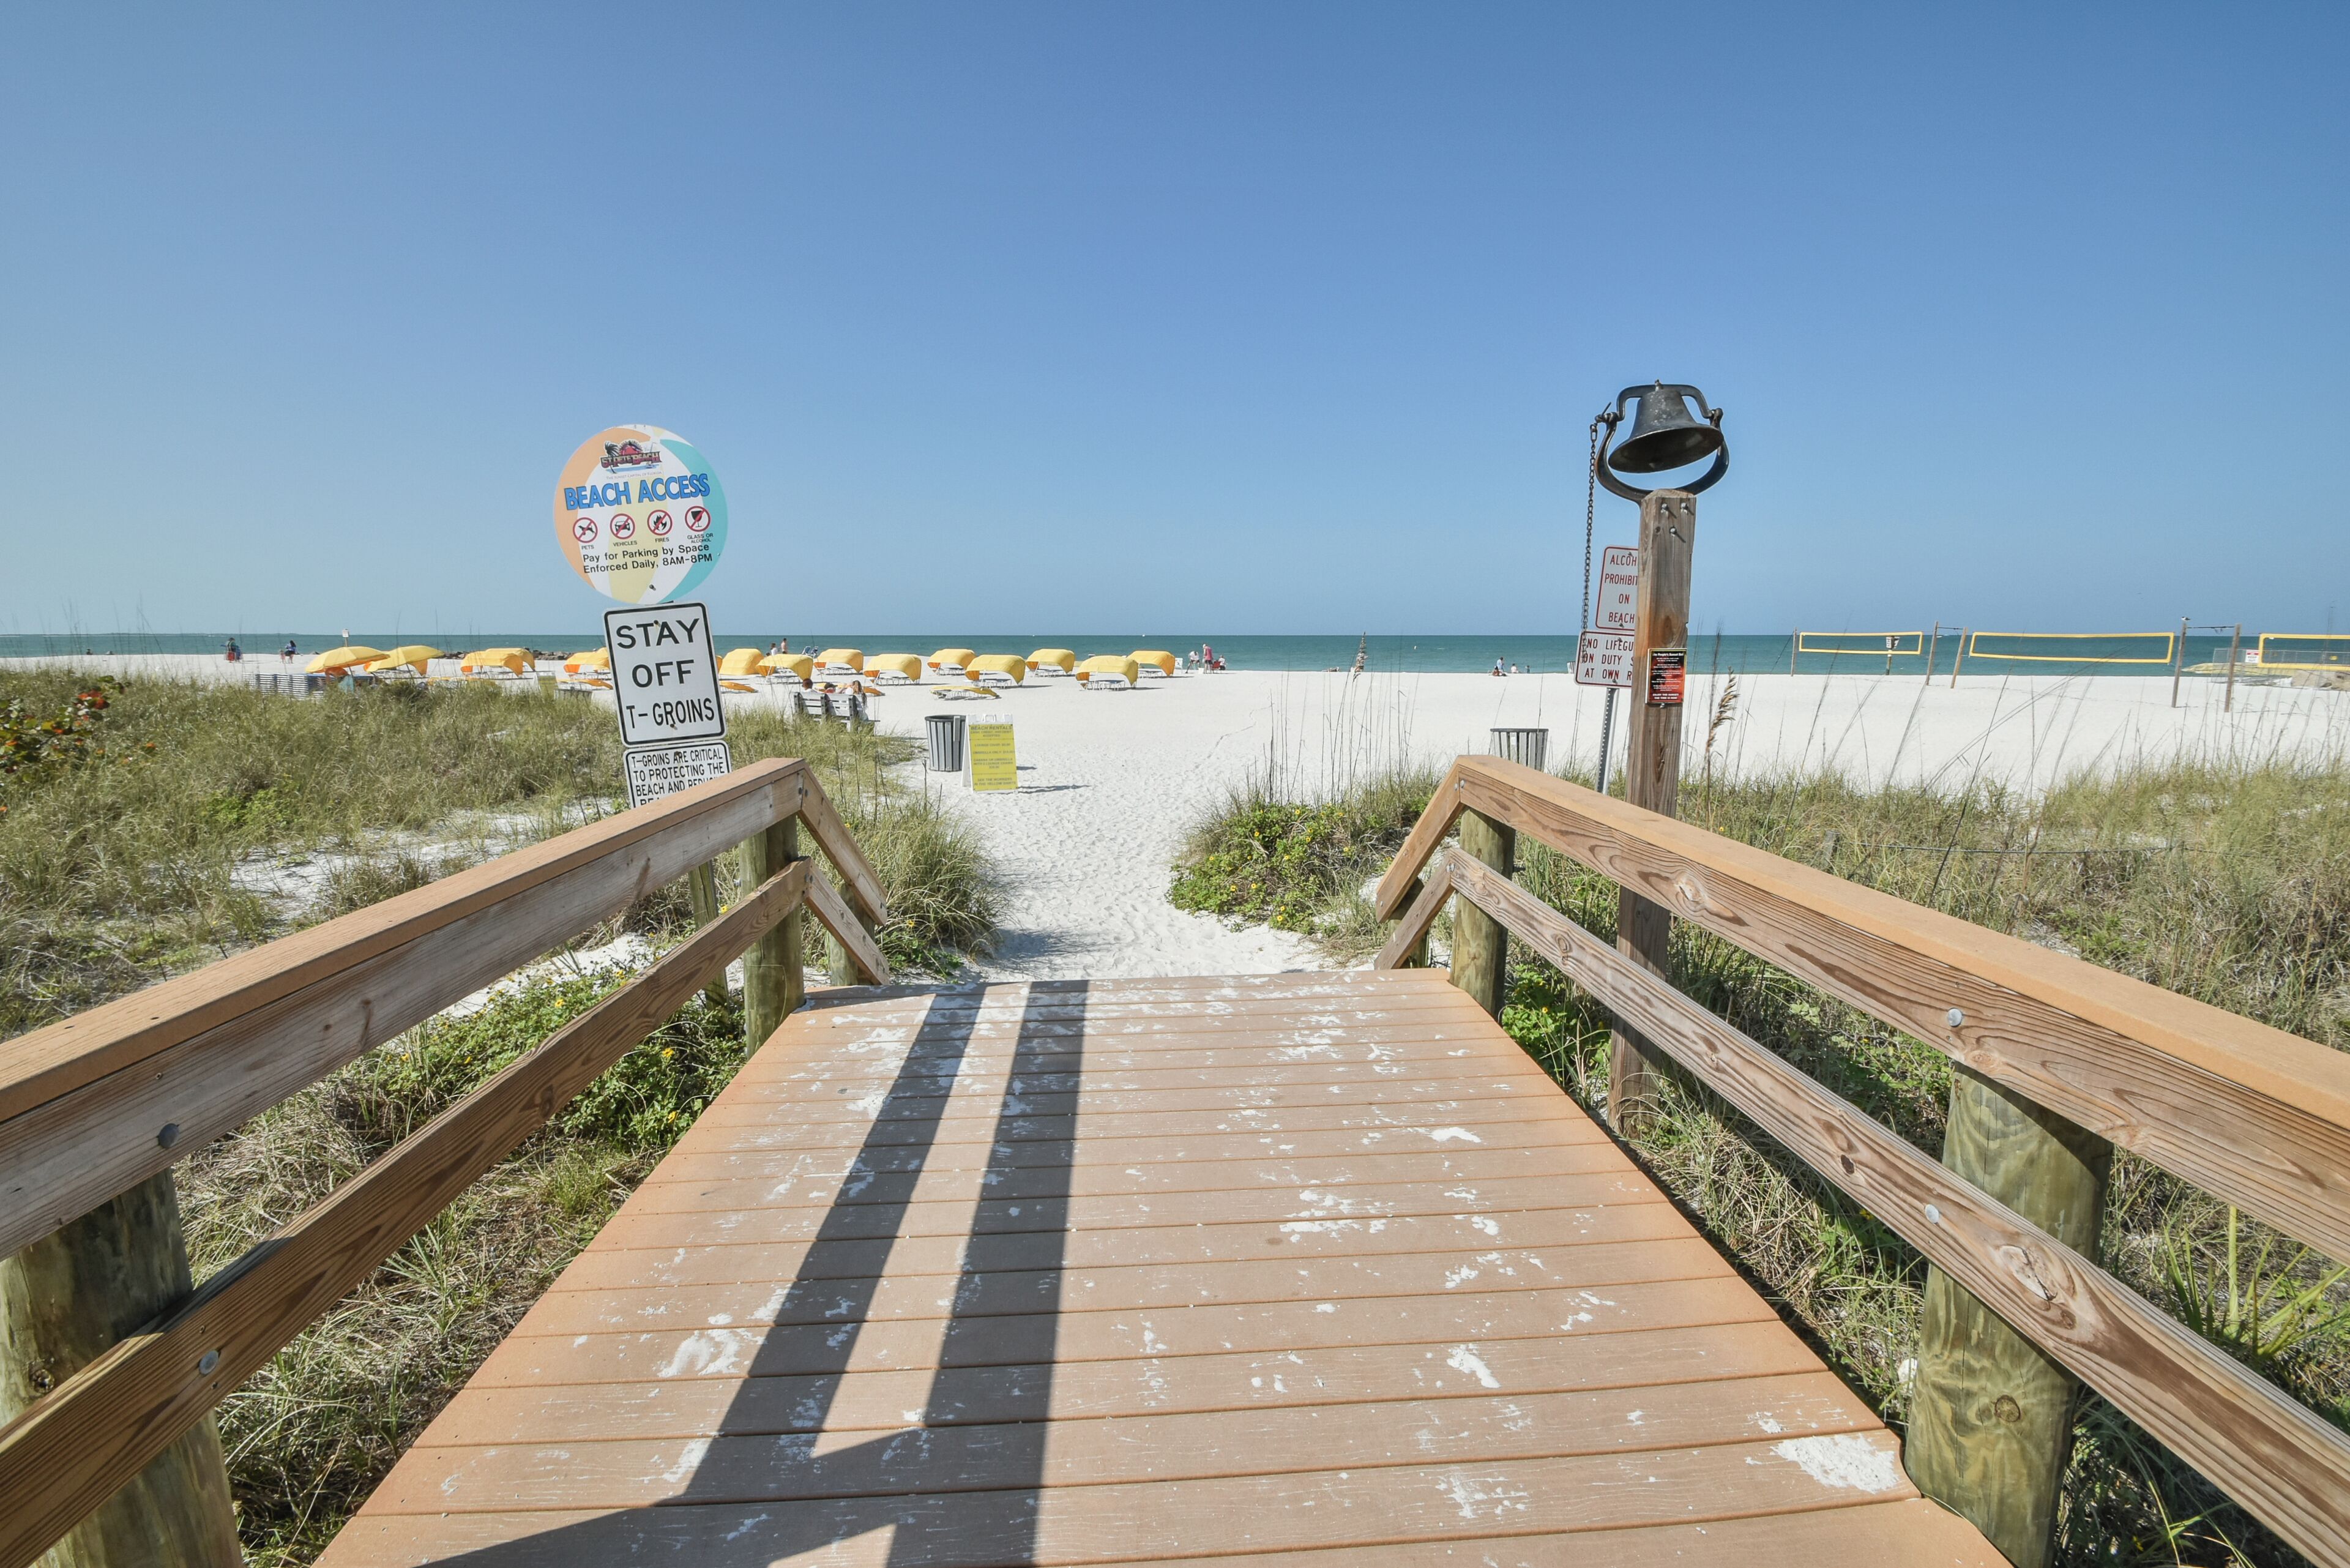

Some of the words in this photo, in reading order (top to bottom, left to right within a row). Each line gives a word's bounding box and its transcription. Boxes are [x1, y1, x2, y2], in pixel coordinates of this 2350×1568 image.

[632, 452, 662, 465] BEACH
[564, 481, 632, 510] BEACH
[638, 473, 710, 503] ACCESS
[622, 548, 658, 558] Parking
[662, 547, 674, 556] by
[678, 544, 709, 554] Space
[583, 562, 628, 573] Enforced
[632, 559, 658, 569] Daily,
[662, 553, 712, 566] 8AM-8PM
[1610, 554, 1637, 566] ALCOH
[1605, 573, 1638, 586] PROHIBIT
[1619, 594, 1630, 604] ON
[1608, 612, 1635, 624] BEACH
[616, 618, 700, 650] STAY
[1587, 638, 1598, 649] NO
[1605, 640, 1634, 651] LIFEGU
[1583, 653, 1594, 663] ON
[1602, 654, 1622, 665] DUTY
[631, 659, 695, 689] OFF
[1584, 668, 1595, 678] AT
[1602, 669, 1619, 680] OWN
[632, 753, 670, 768] T-GROINS
[673, 751, 688, 764] ARE
[690, 748, 723, 762] CRITICAL
[633, 770, 646, 783] TO
[649, 764, 704, 782] PROTECTING
[707, 762, 725, 775] THE
[635, 782, 665, 796] BEACH
[668, 780, 685, 793] AND
